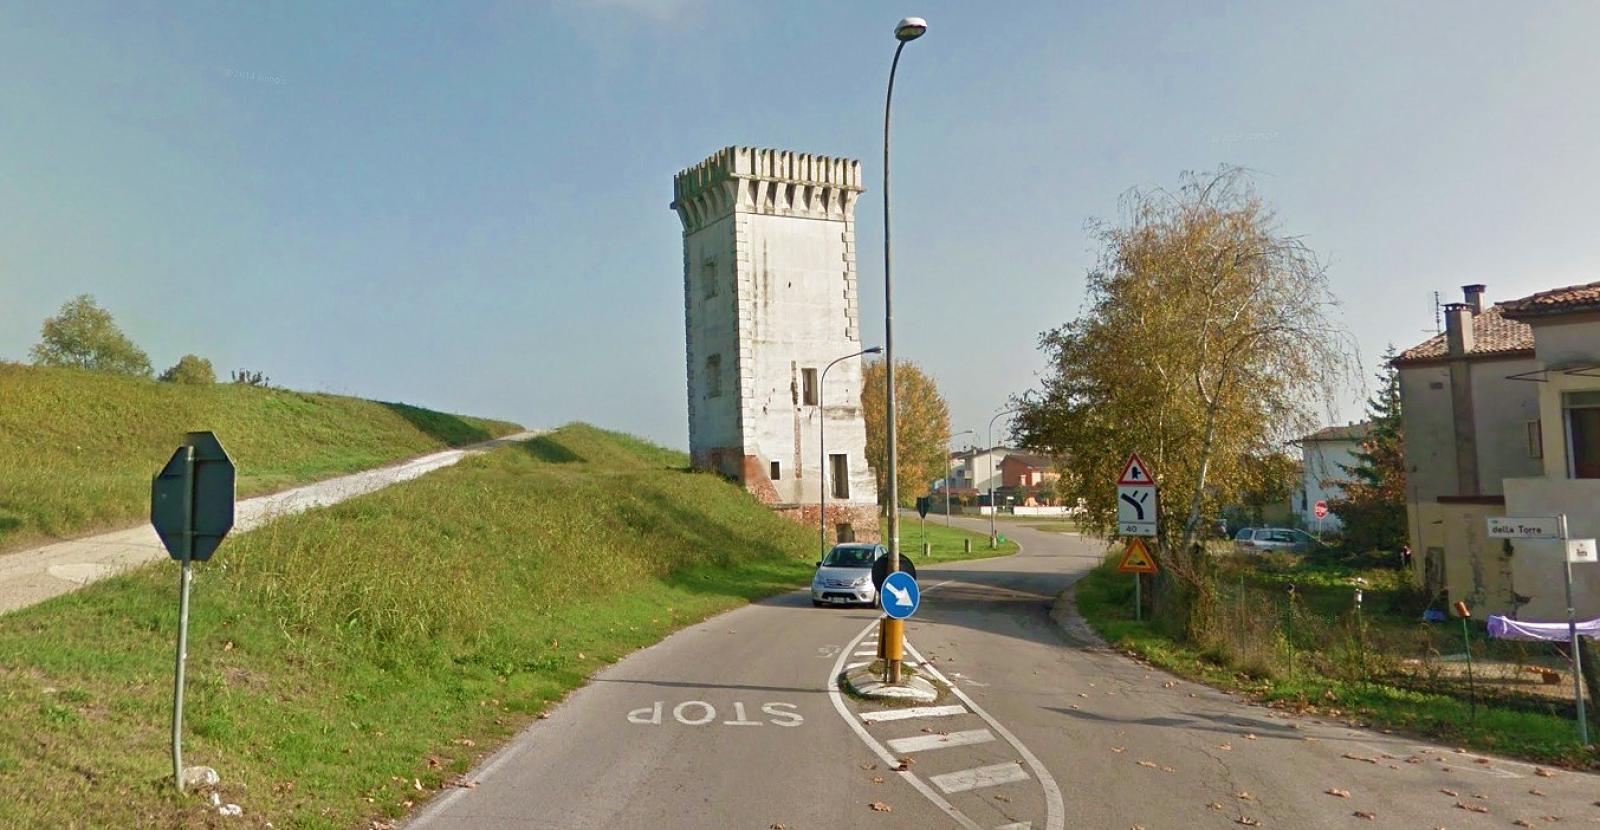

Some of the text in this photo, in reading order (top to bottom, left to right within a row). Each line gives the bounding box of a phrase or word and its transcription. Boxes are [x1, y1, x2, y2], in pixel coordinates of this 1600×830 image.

[1492, 525, 1542, 534] della Torre
[627, 700, 804, 727] STOP
